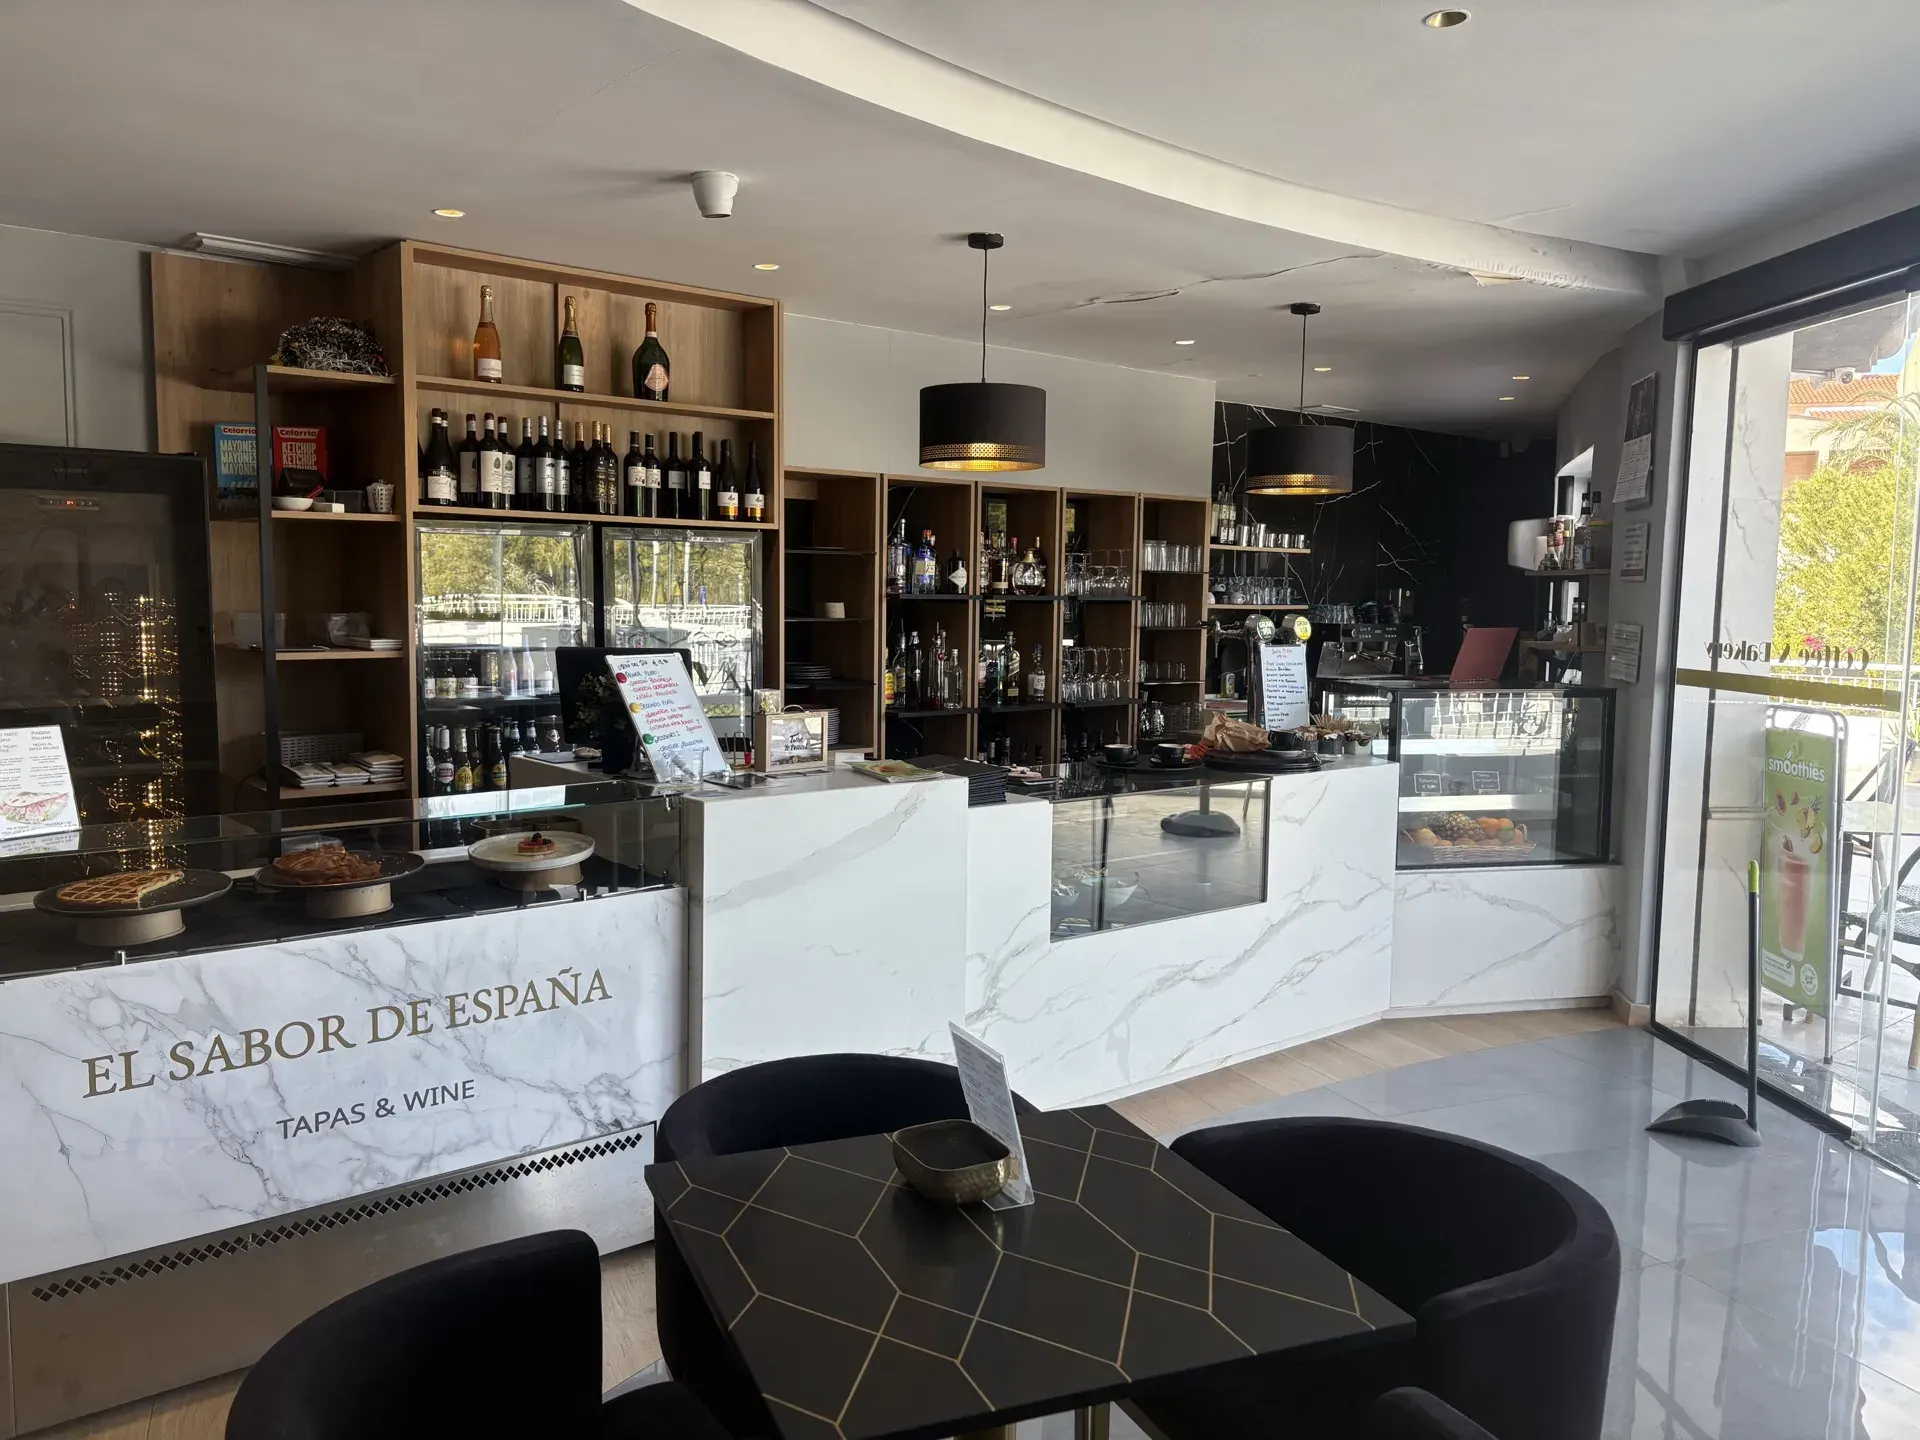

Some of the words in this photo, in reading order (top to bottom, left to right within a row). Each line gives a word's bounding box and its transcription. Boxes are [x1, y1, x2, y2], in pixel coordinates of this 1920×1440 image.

[279, 429, 317, 437] Celorrio
[219, 439, 257, 452] MAYONES
[281, 441, 317, 454] KETCHUP
[220, 451, 257, 464] MAYONES
[282, 453, 318, 465] KETCHUP
[82, 1050, 155, 1099] EL
[168, 1014, 357, 1083] SABOR
[366, 998, 435, 1044] DE
[443, 966, 613, 1029] ESPAÑA
[276, 1102, 366, 1141] TAPAS
[374, 1096, 396, 1119] &
[403, 1078, 476, 1112] WINE
